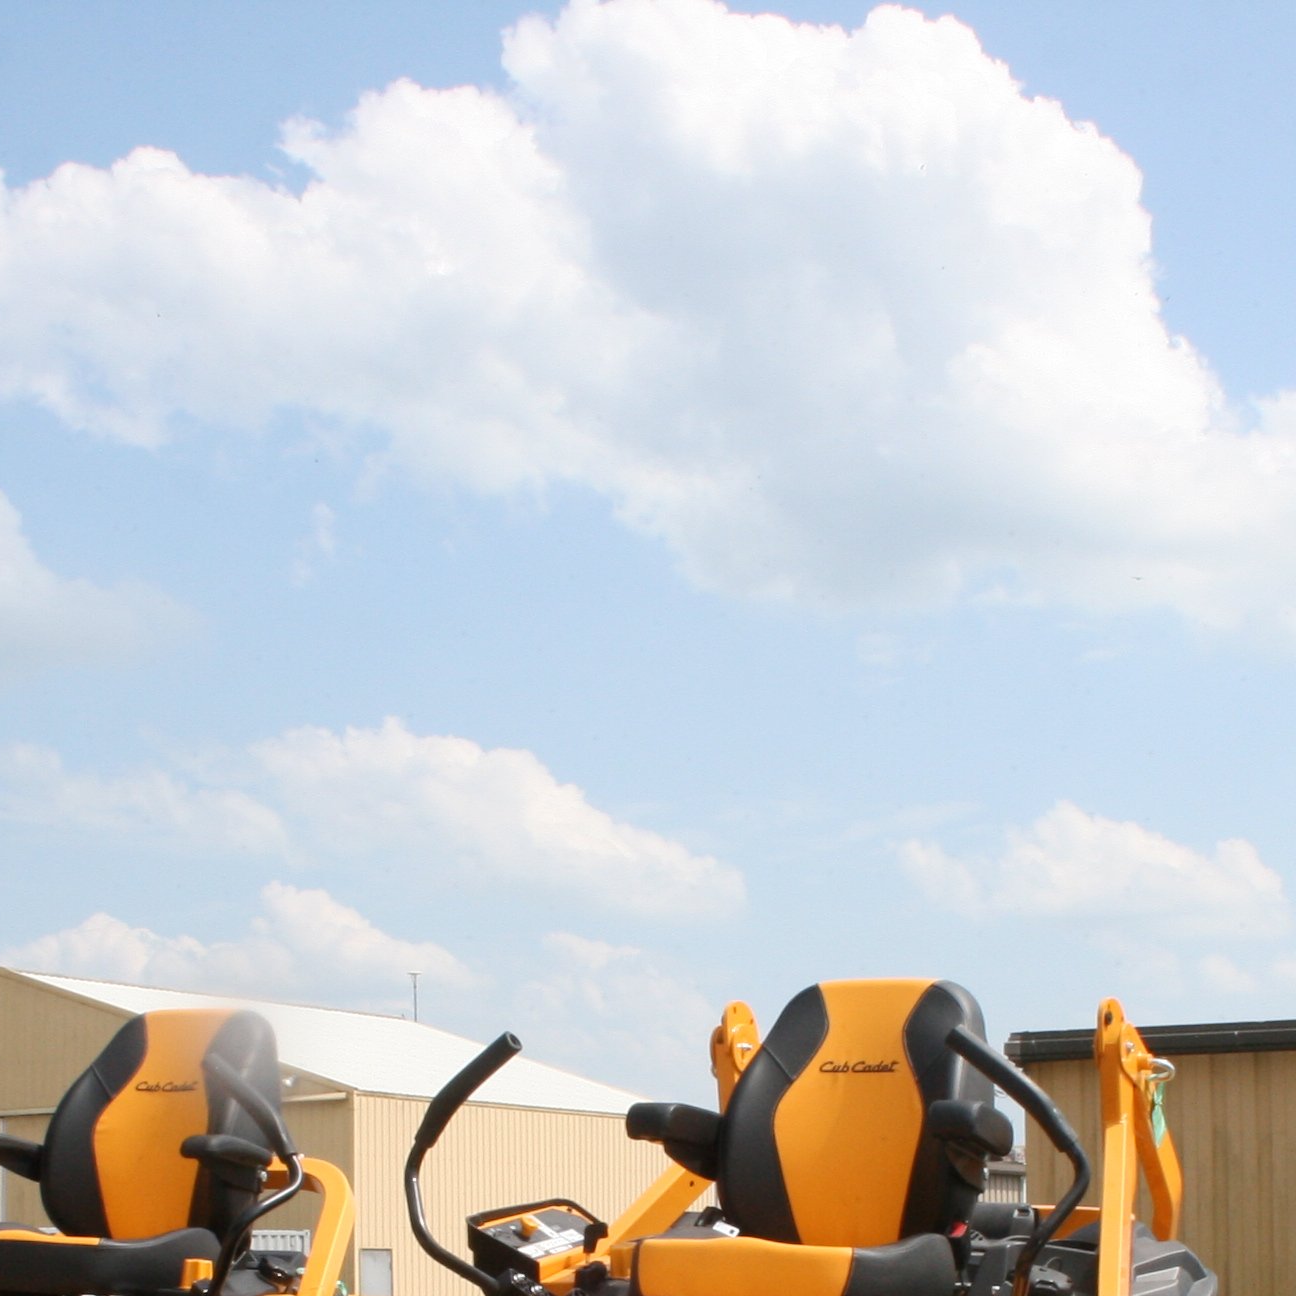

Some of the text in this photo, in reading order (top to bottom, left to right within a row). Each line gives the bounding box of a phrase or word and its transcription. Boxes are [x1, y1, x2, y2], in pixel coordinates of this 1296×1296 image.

[819, 1061, 899, 1073] Cub Cadet
[135, 1081, 161, 1092] Cub
